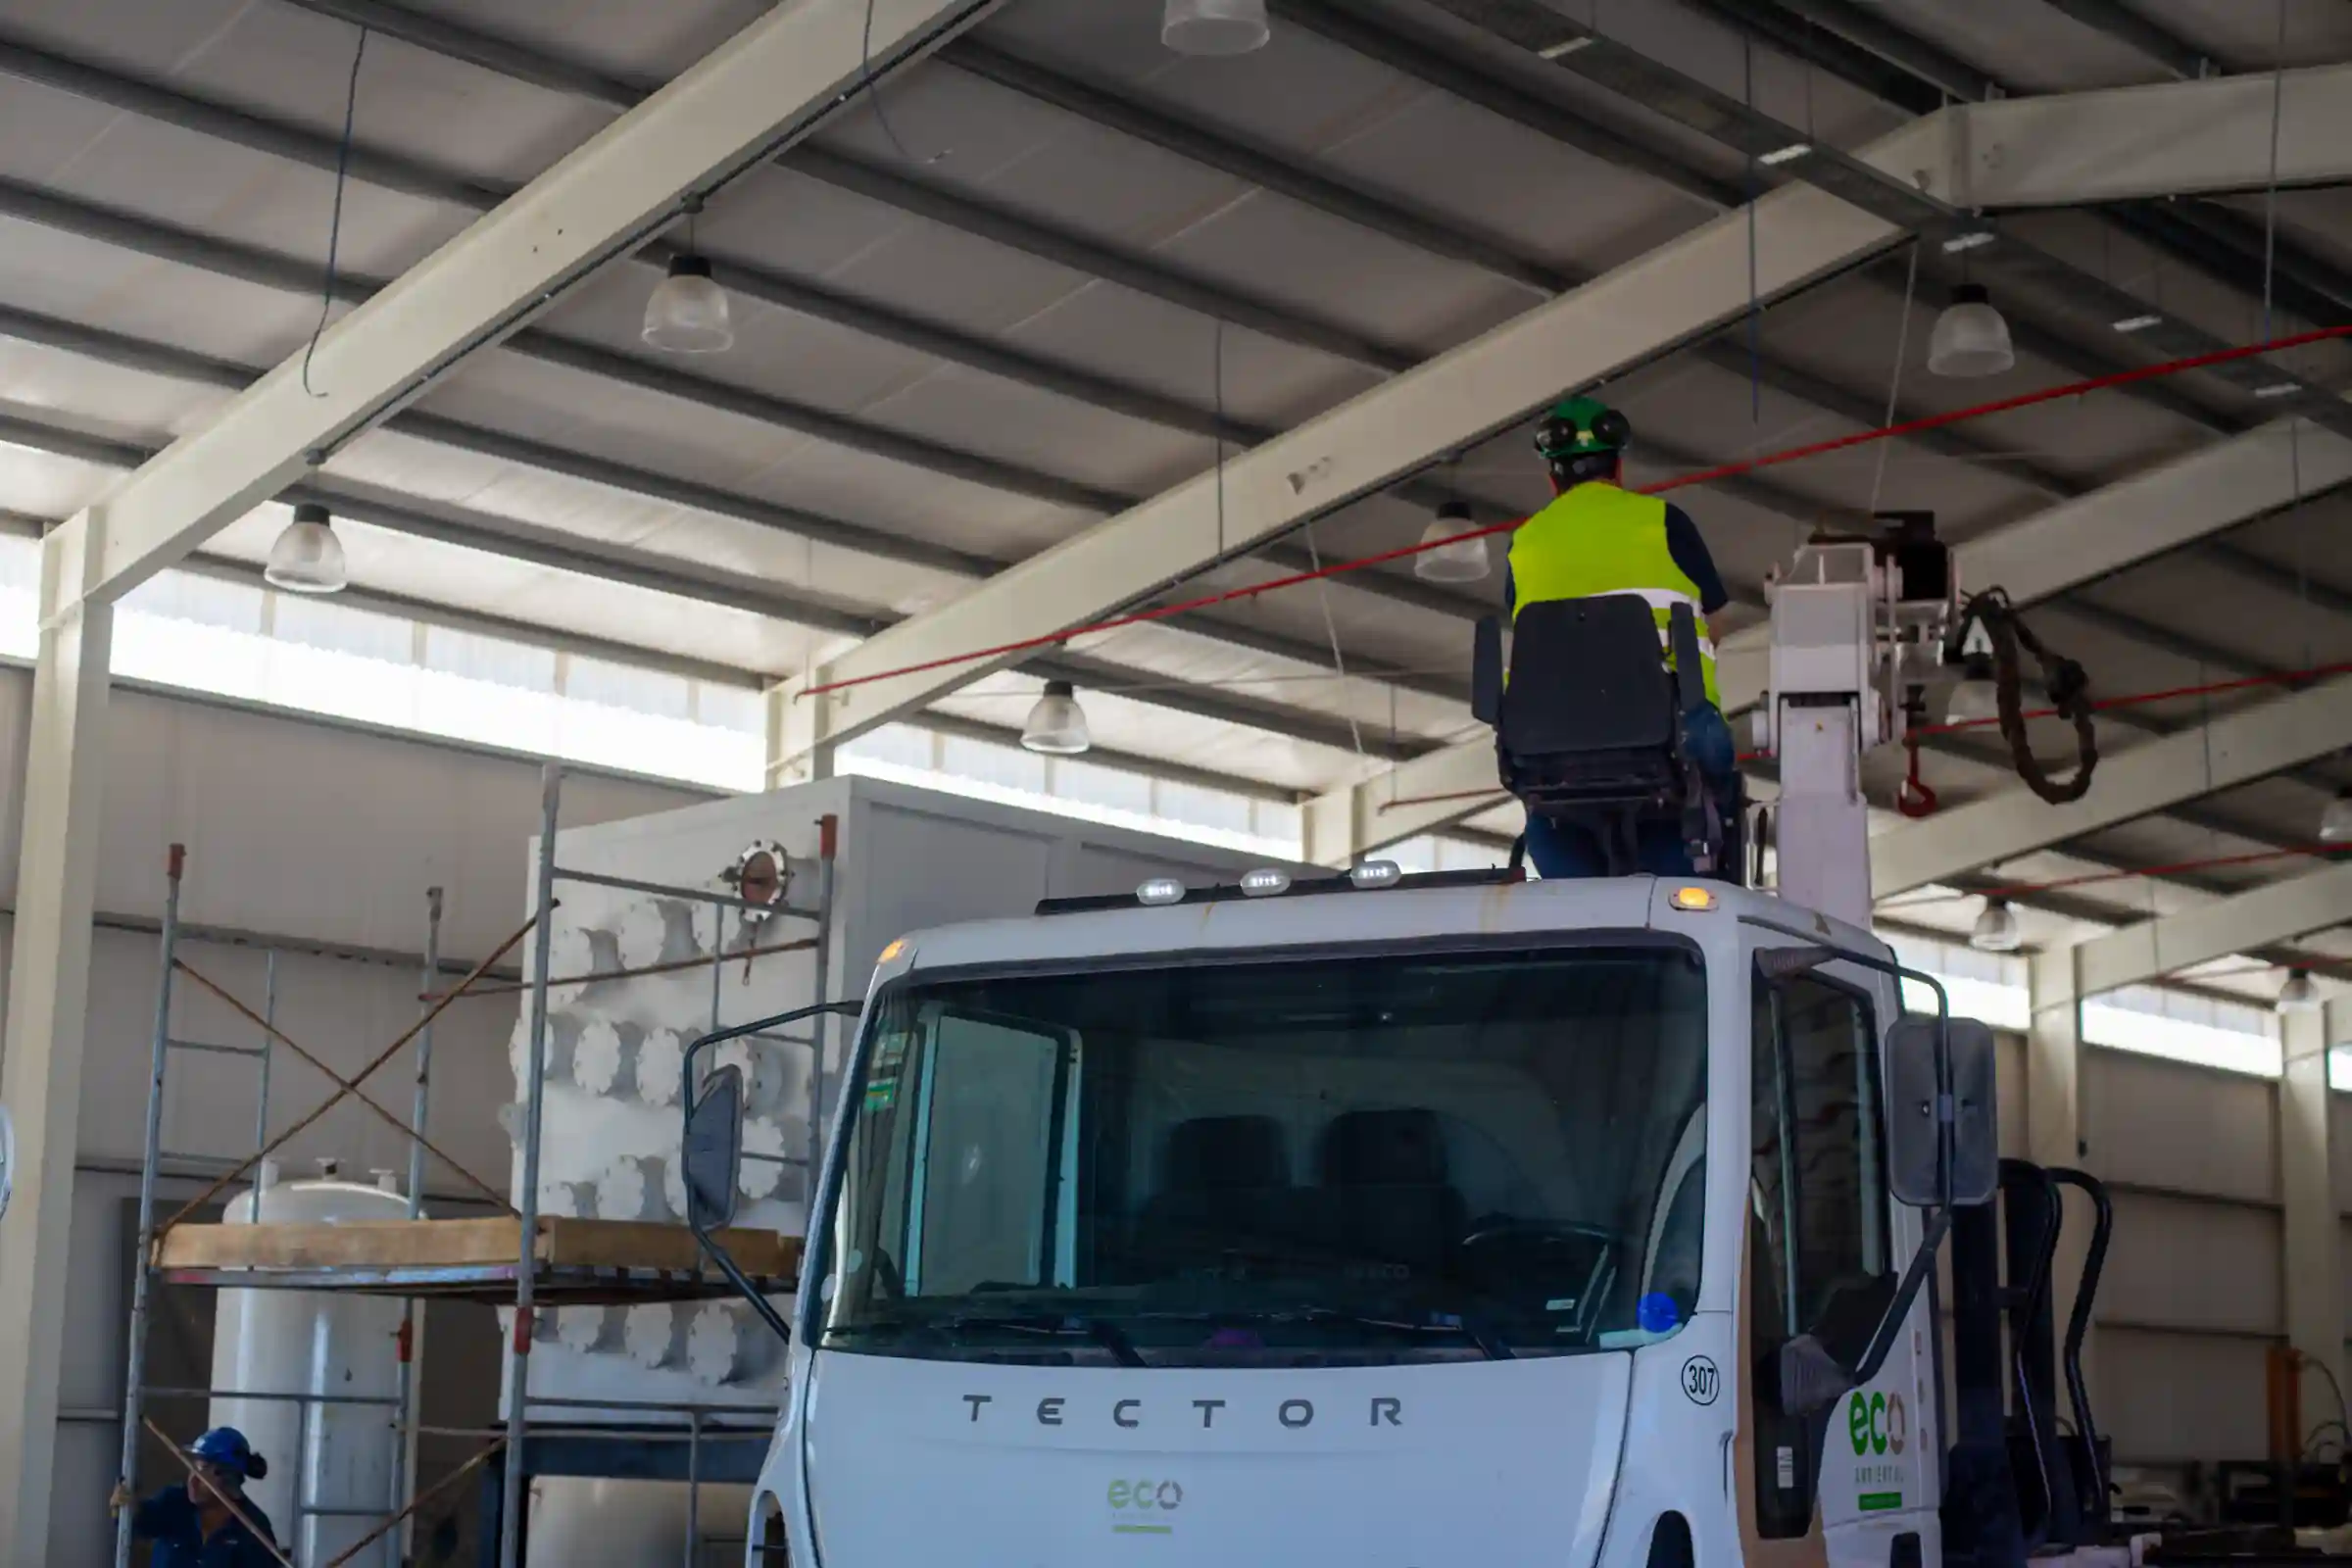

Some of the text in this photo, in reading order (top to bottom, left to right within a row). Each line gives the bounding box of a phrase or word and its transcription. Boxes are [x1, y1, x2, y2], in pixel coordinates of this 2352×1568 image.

[1689, 1364, 1714, 1397] 307
[962, 1394, 1402, 1428] TECTOR
[1848, 1391, 1906, 1455] eco
[1108, 1479, 1183, 1511] eco
